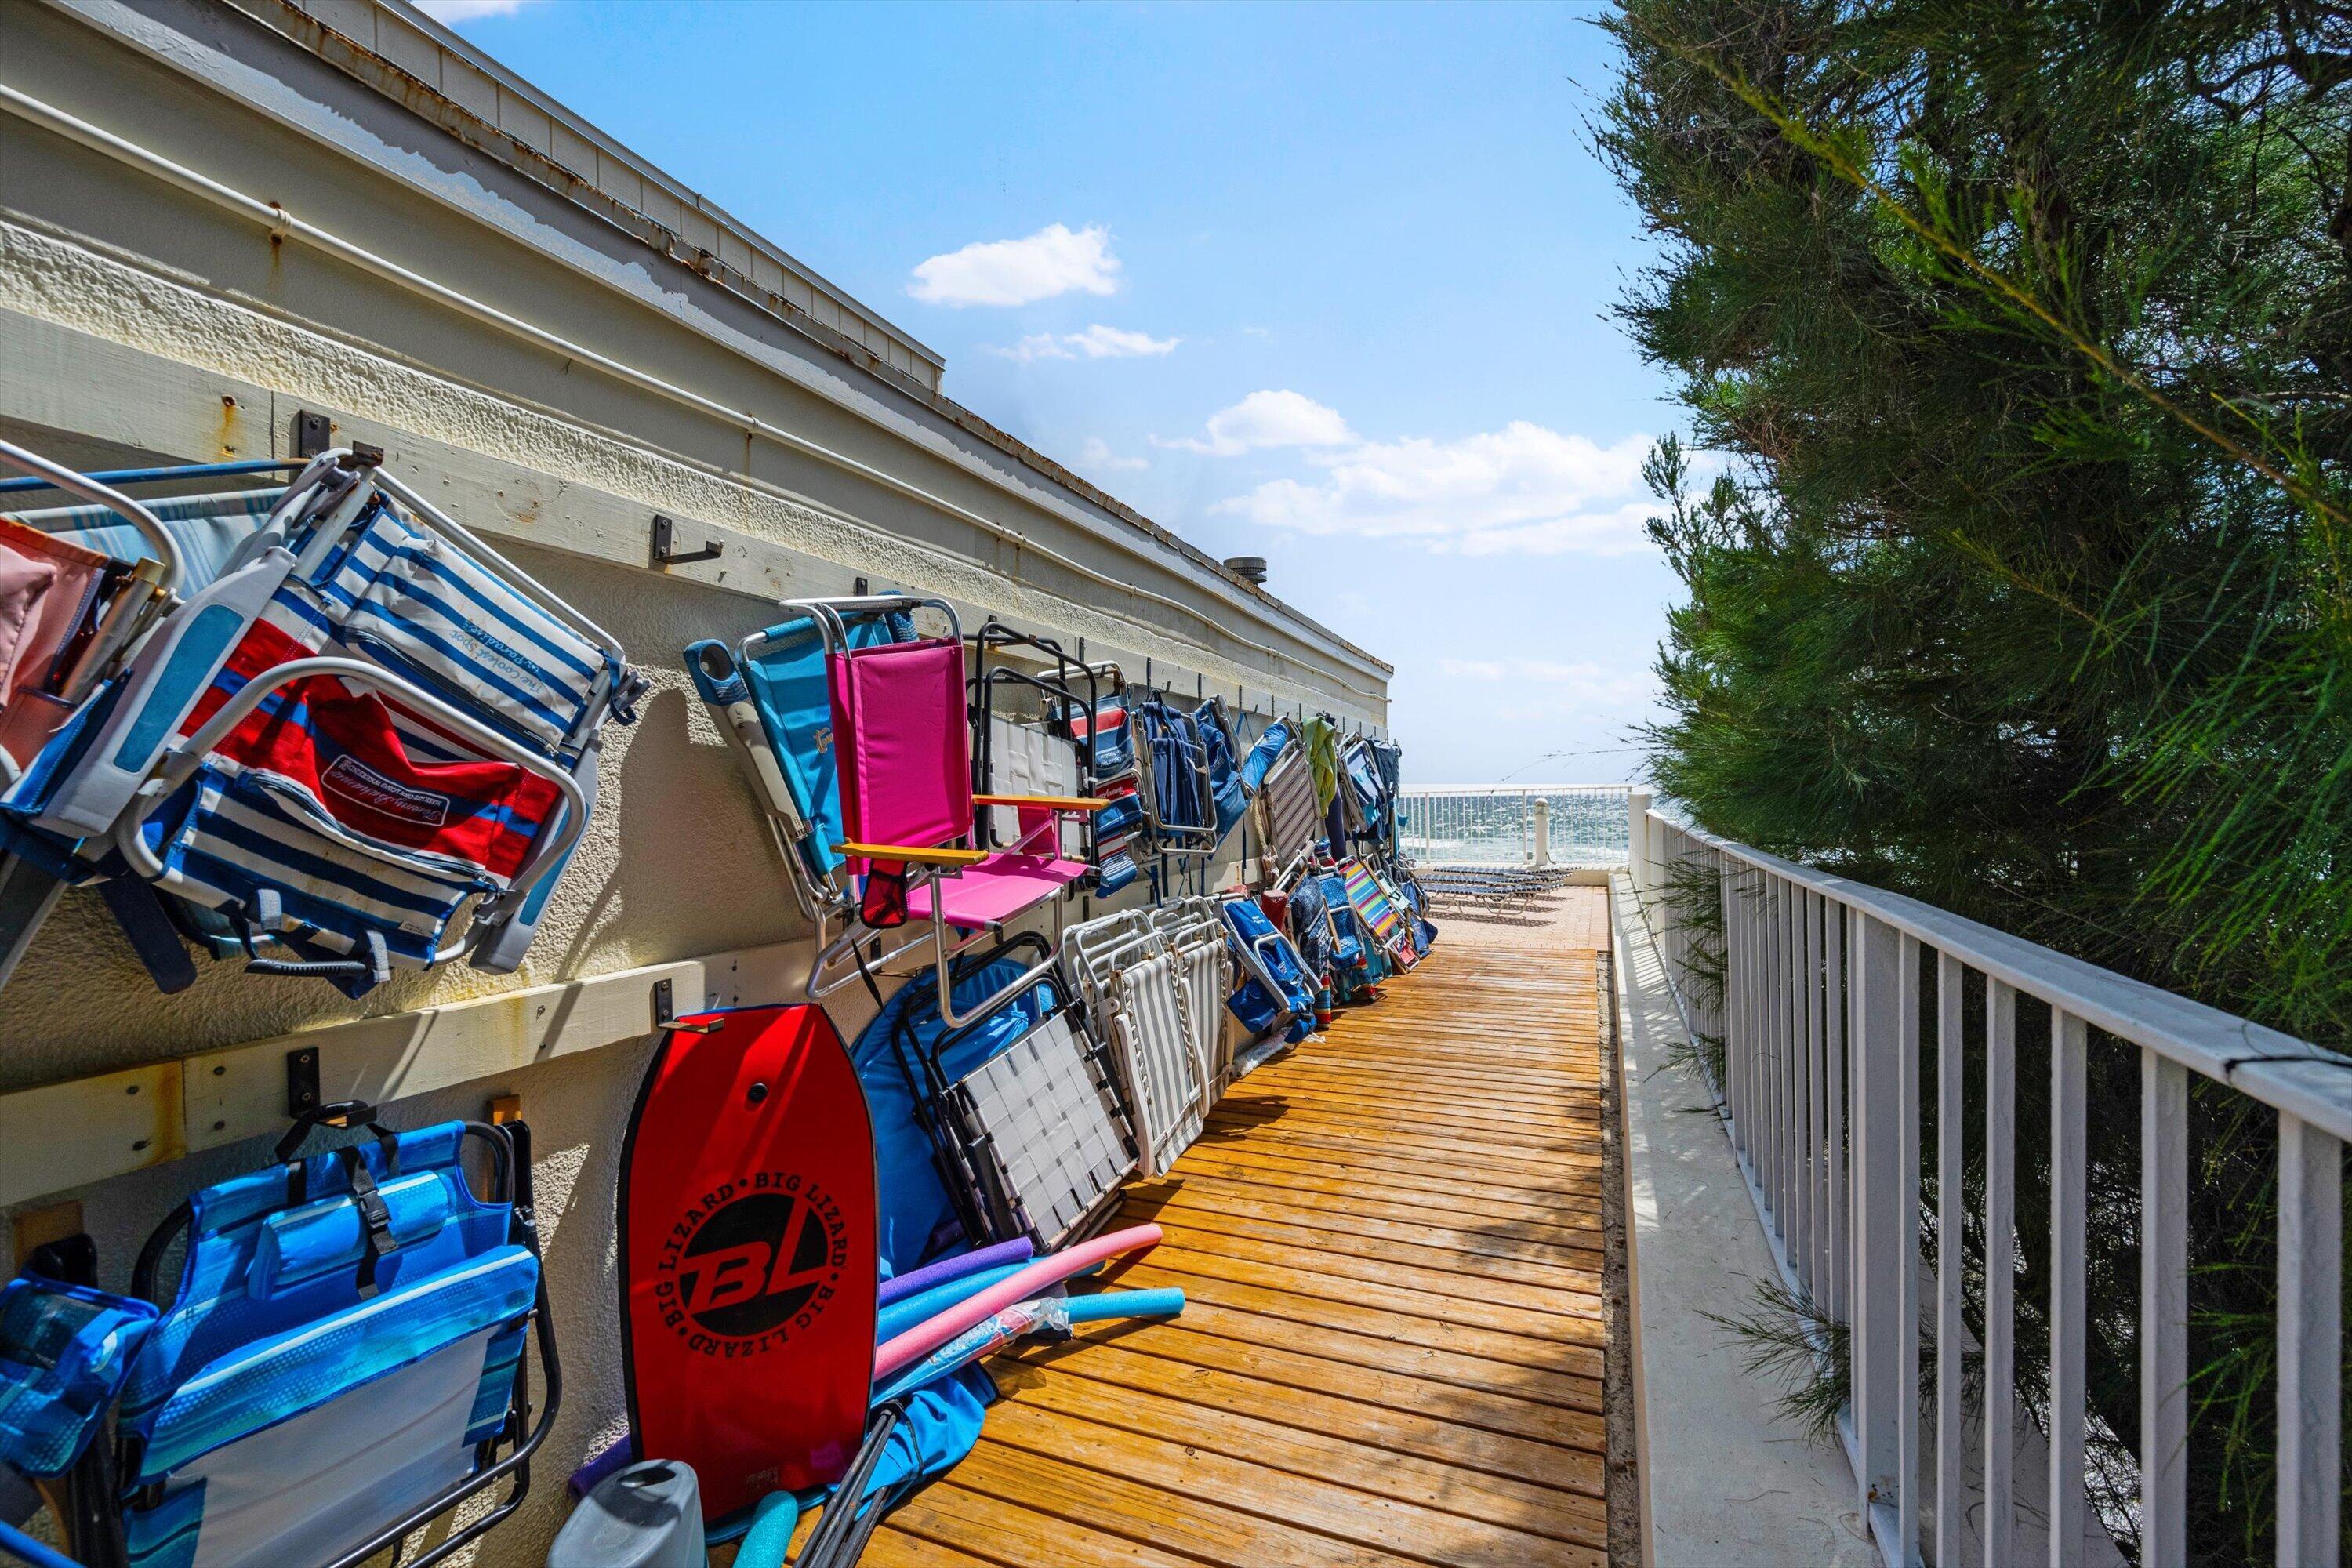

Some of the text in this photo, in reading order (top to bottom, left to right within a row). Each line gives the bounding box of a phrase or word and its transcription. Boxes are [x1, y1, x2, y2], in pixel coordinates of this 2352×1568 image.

[449, 630, 543, 693] The Coolest Spot
[468, 624, 524, 665] Paradise
[329, 770, 441, 821] Tommy Bahama
[655, 1184, 735, 1328] BIG LIZARD
[677, 1196, 829, 1315] BL
[754, 1172, 848, 1269] BIG LIZARD
[688, 1285, 837, 1359] BIG LIZARD
